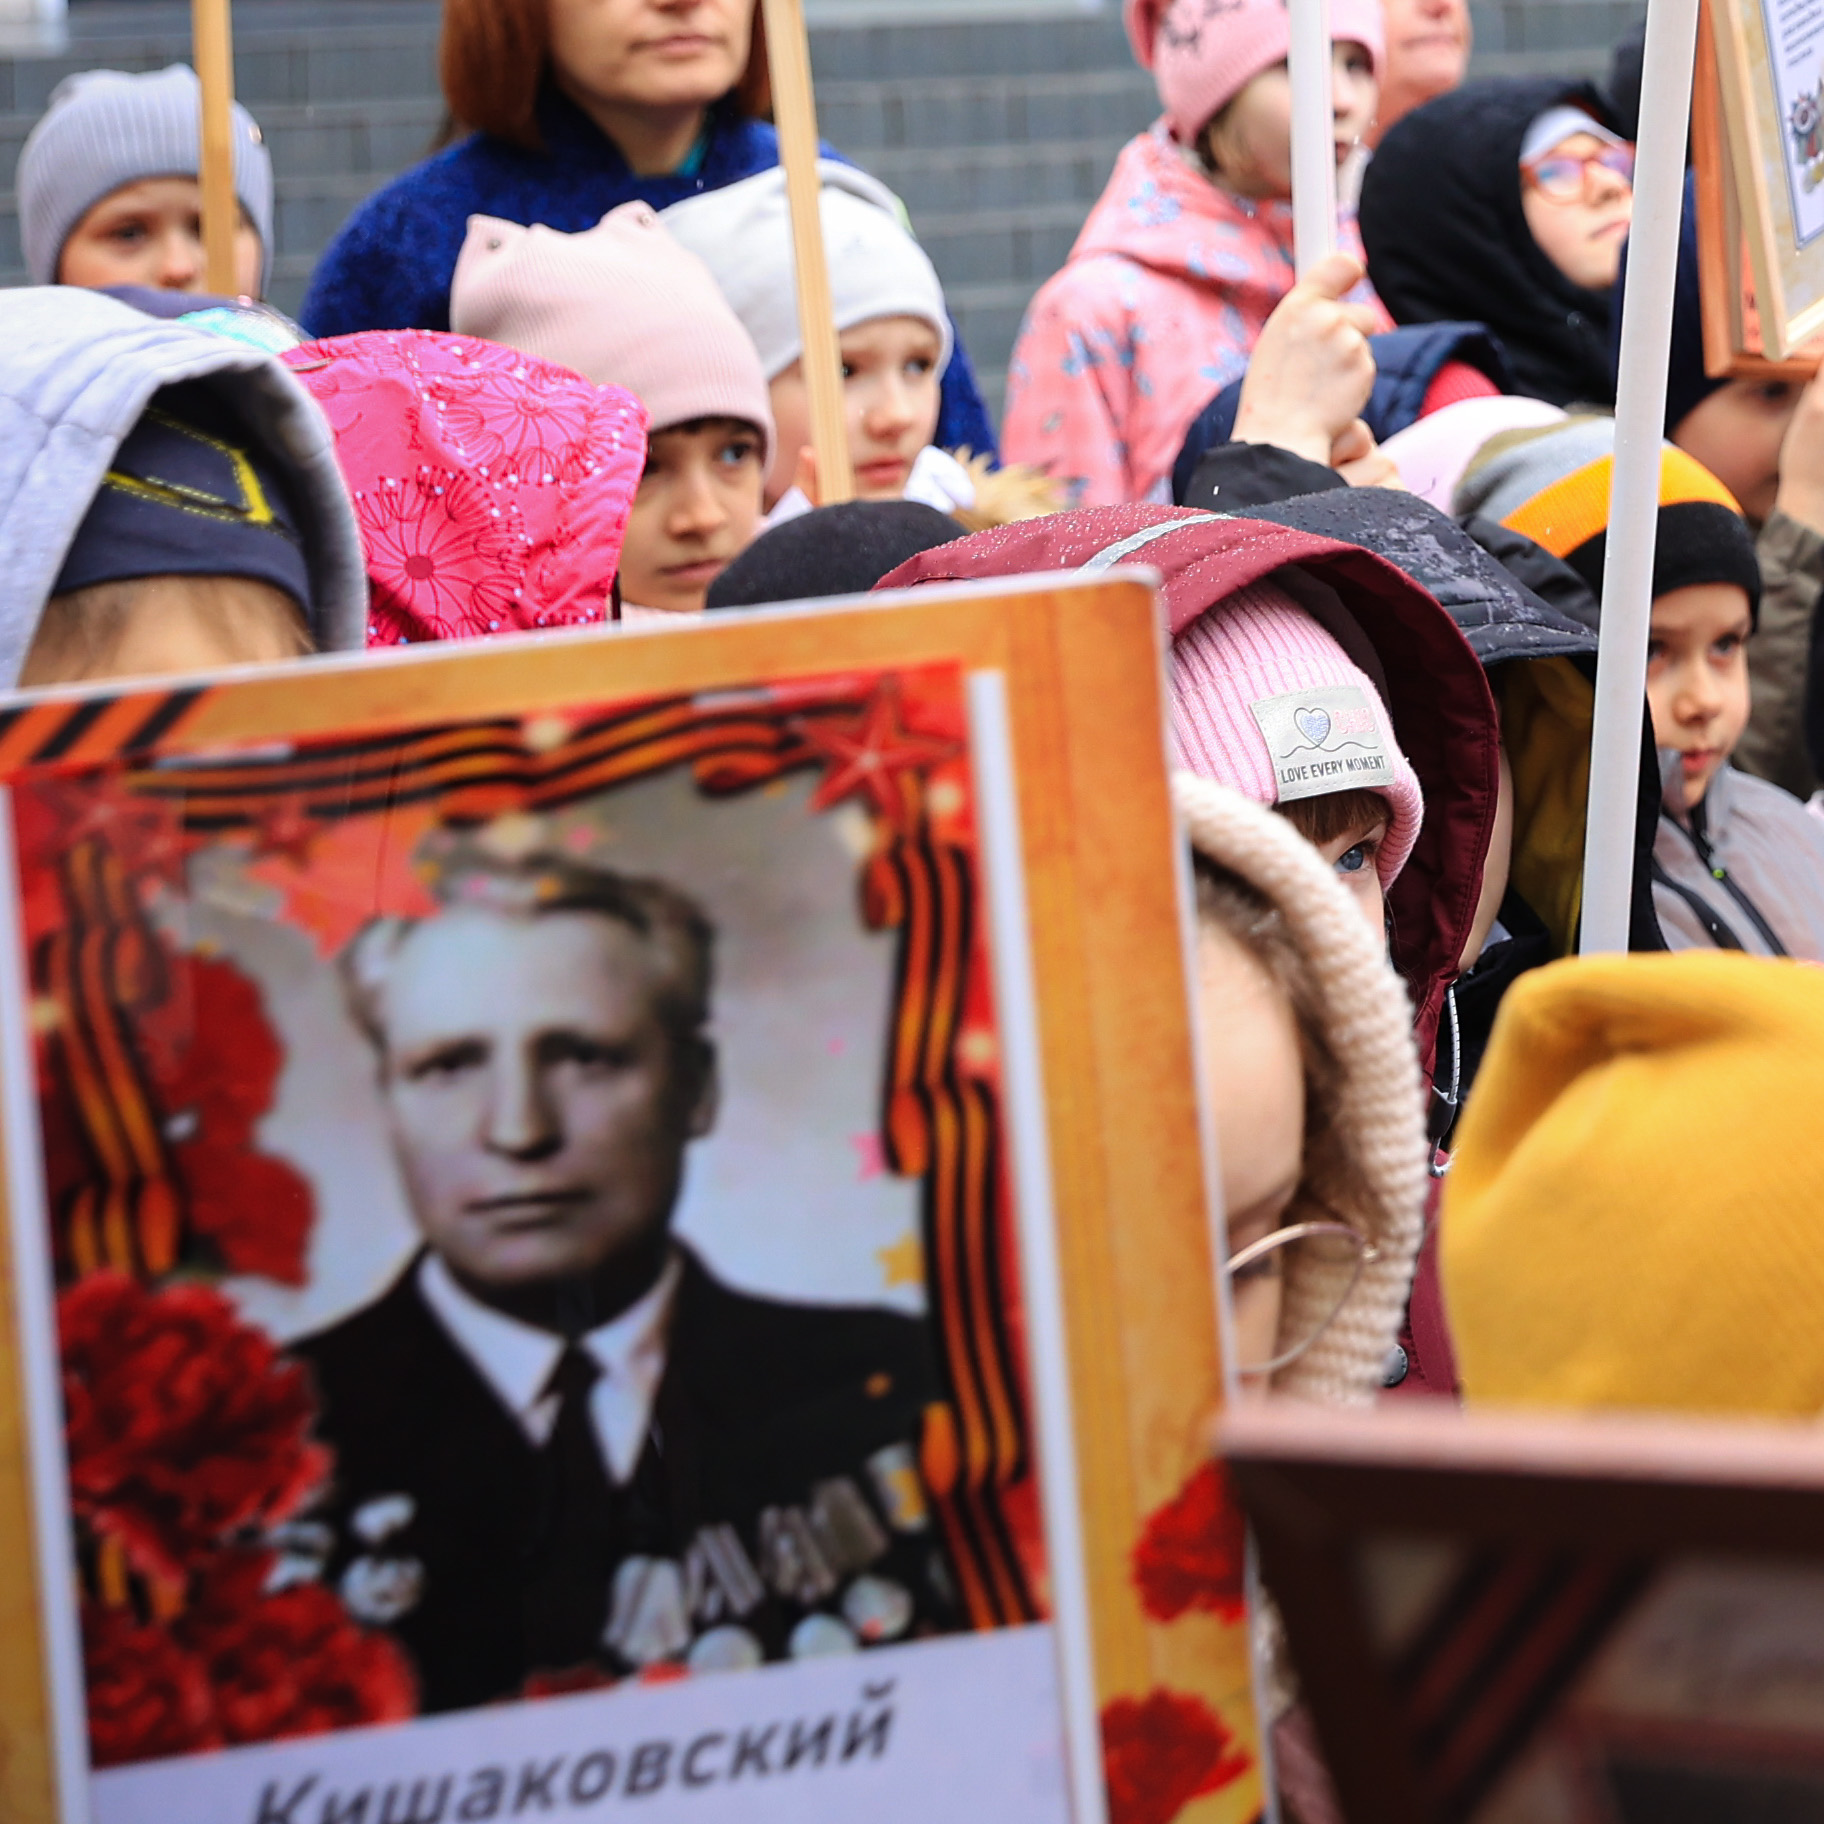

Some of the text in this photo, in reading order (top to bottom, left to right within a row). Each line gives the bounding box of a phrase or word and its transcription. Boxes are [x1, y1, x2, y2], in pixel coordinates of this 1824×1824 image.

[1280, 755, 1386, 784] LOVE EVERY MOMENT
[250, 1676, 896, 1824] Кишаковский
